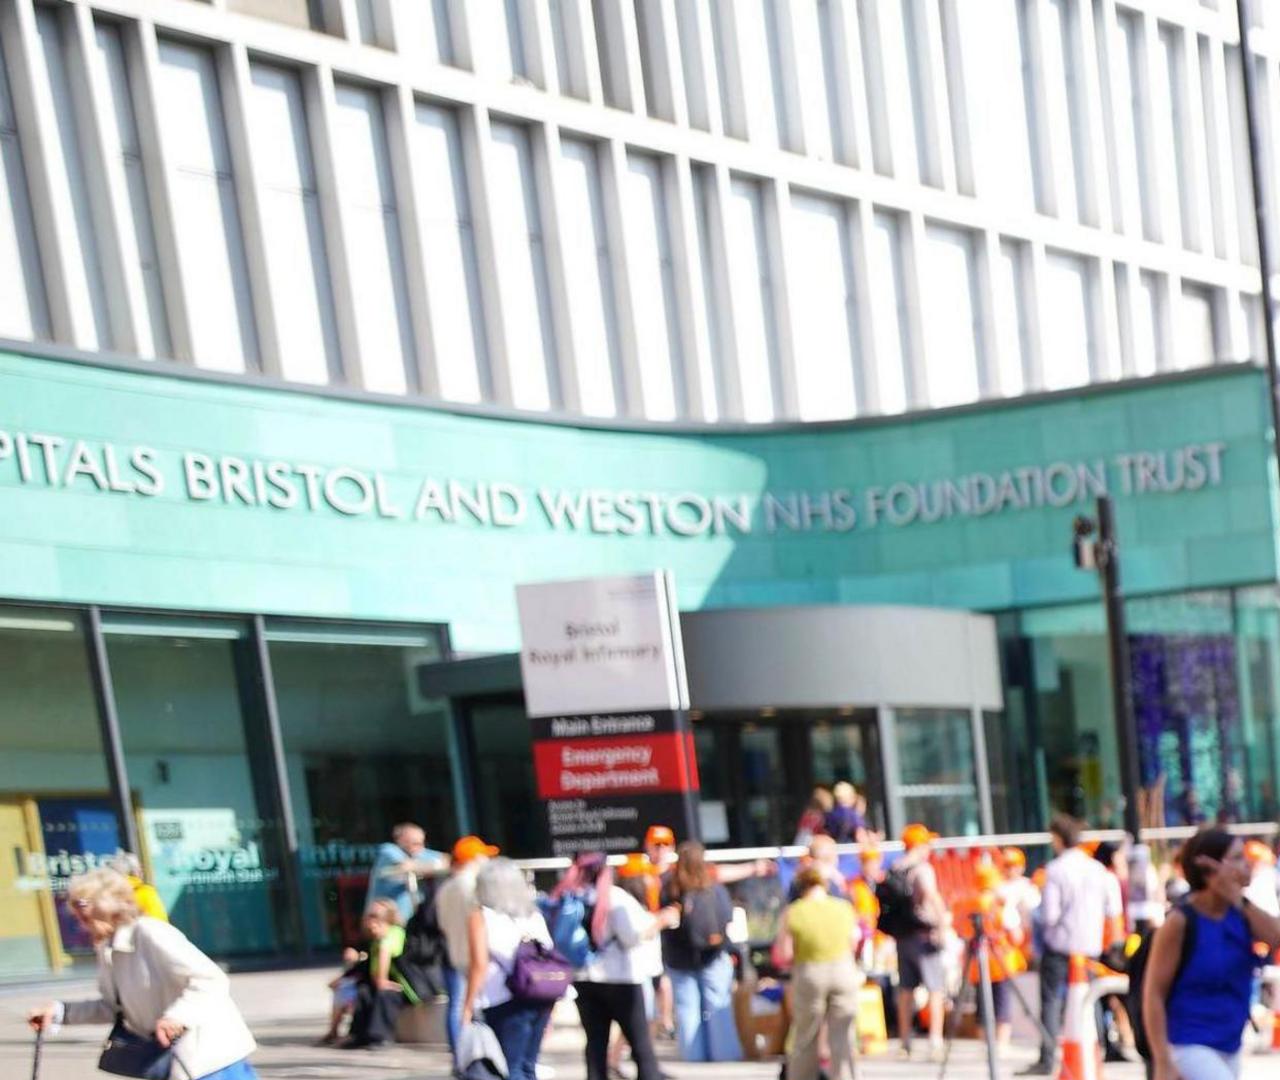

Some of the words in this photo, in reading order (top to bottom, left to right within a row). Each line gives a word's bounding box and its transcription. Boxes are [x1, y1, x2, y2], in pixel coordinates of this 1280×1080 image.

[183, 450, 400, 518] BRISTOL
[415, 476, 525, 527] AND
[536, 485, 753, 537] WESTON
[765, 491, 857, 533] NHS
[865, 459, 1107, 527] FOUNDATION
[1116, 441, 1227, 496] TRUST
[552, 716, 589, 736] Main
[591, 714, 655, 735] Entrance
[561, 746, 653, 768] Emergency
[560, 768, 660, 793] Department
